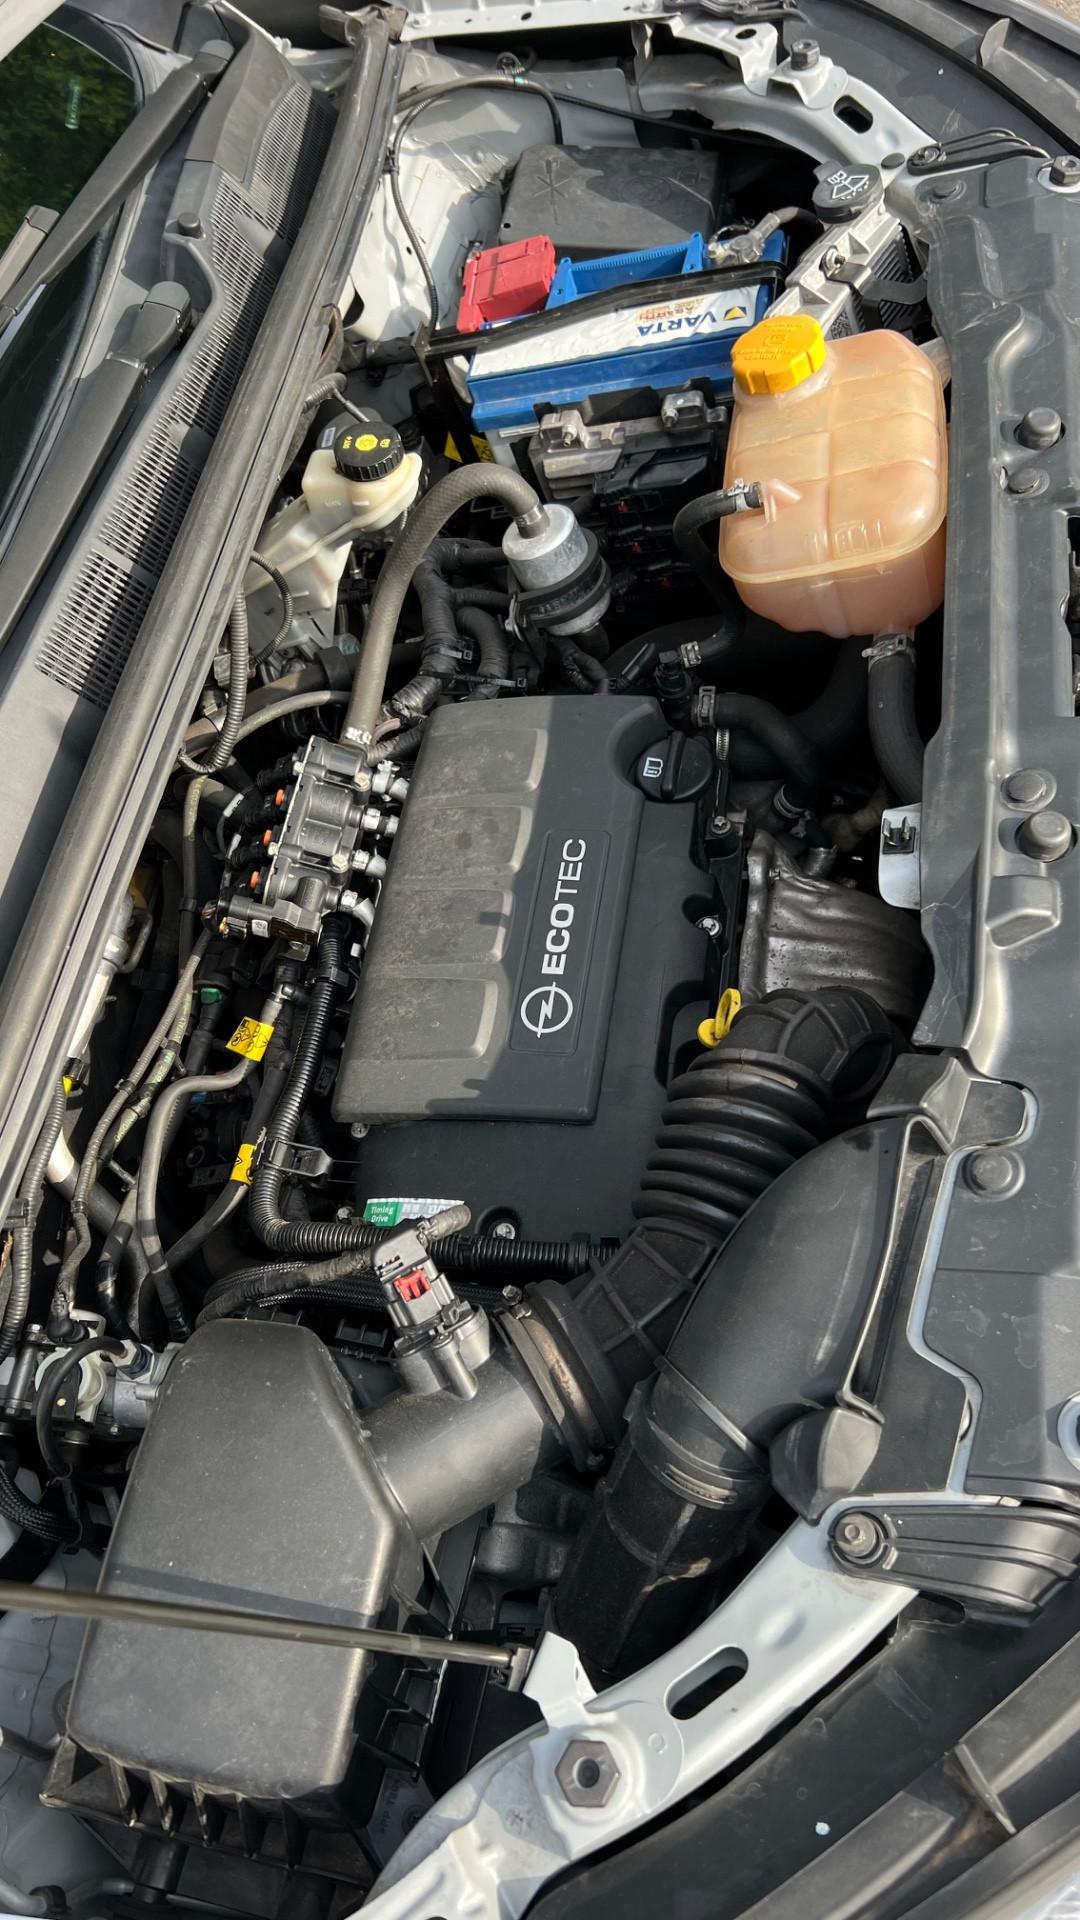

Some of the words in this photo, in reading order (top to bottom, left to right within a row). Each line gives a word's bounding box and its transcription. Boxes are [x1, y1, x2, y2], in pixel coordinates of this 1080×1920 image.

[637, 311, 717, 336] VARTA
[541, 838, 587, 975] ECOTEC
[370, 1206, 394, 1215] Timing
[370, 1214, 389, 1223] Drive
